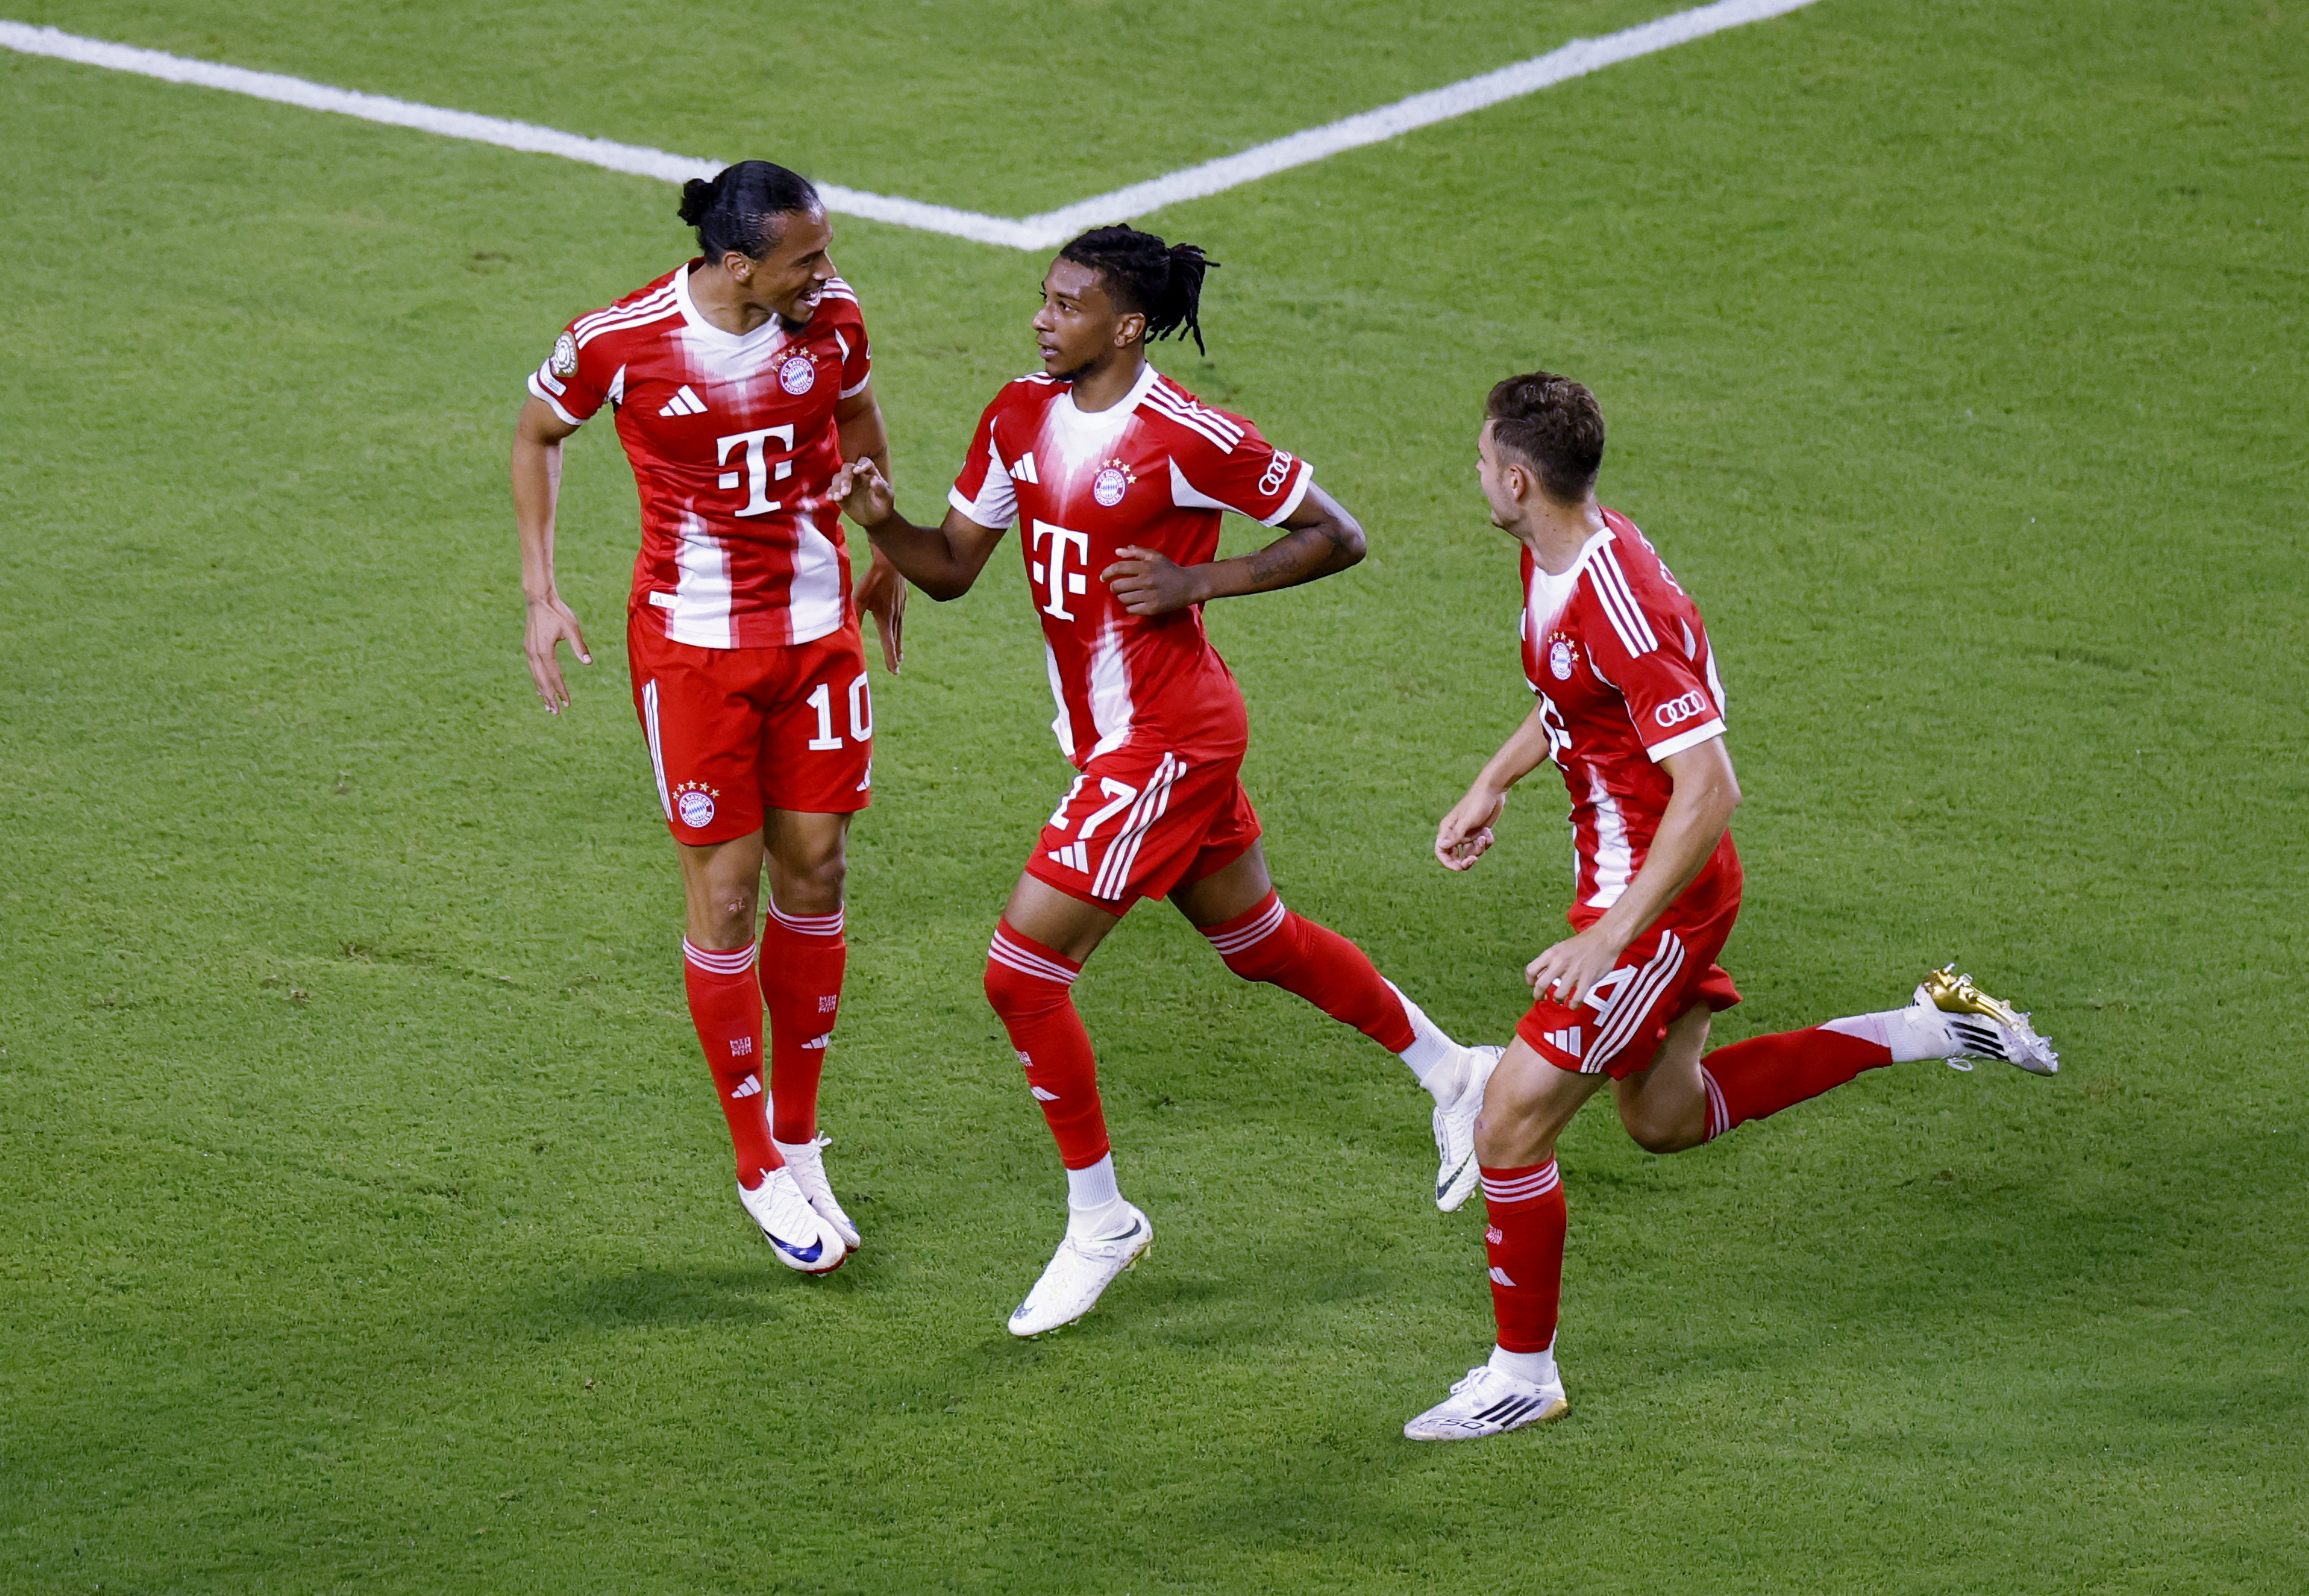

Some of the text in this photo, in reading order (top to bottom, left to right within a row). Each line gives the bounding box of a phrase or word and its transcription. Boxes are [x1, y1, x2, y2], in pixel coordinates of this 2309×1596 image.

[783, 359, 810, 377] FC BAYERN
[717, 423, 794, 518] T
[1032, 518, 1089, 623] T
[806, 671, 873, 750] 10
[687, 794, 711, 807] BAYERN
[1049, 774, 1138, 840] 17
[819, 994, 837, 1003] MIA
[819, 1000, 836, 1008] SAN
[1552, 964, 1638, 1027] 4
[729, 1036, 751, 1048] MIA
